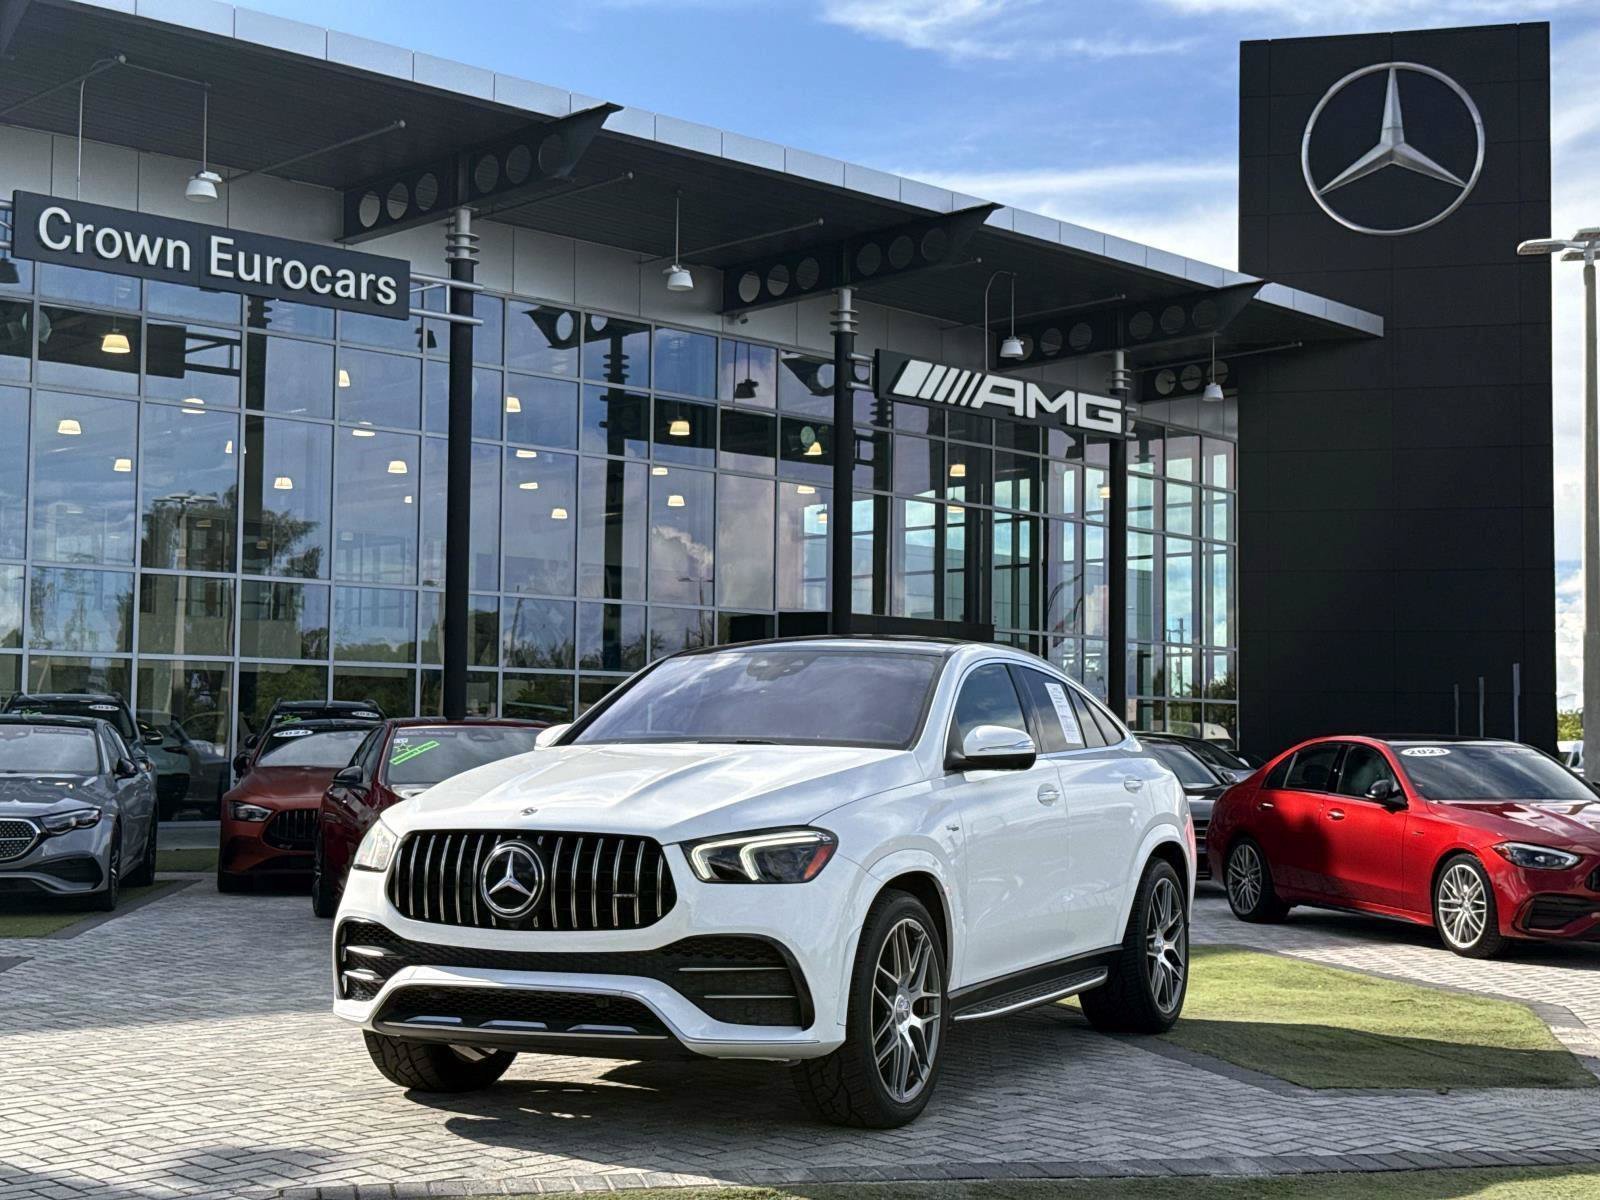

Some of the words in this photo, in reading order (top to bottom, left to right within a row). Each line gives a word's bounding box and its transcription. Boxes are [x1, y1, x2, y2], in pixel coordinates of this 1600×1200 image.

[38, 206, 191, 272] Crown
[209, 234, 398, 305] Eurocars
[970, 374, 1122, 433] AMG
